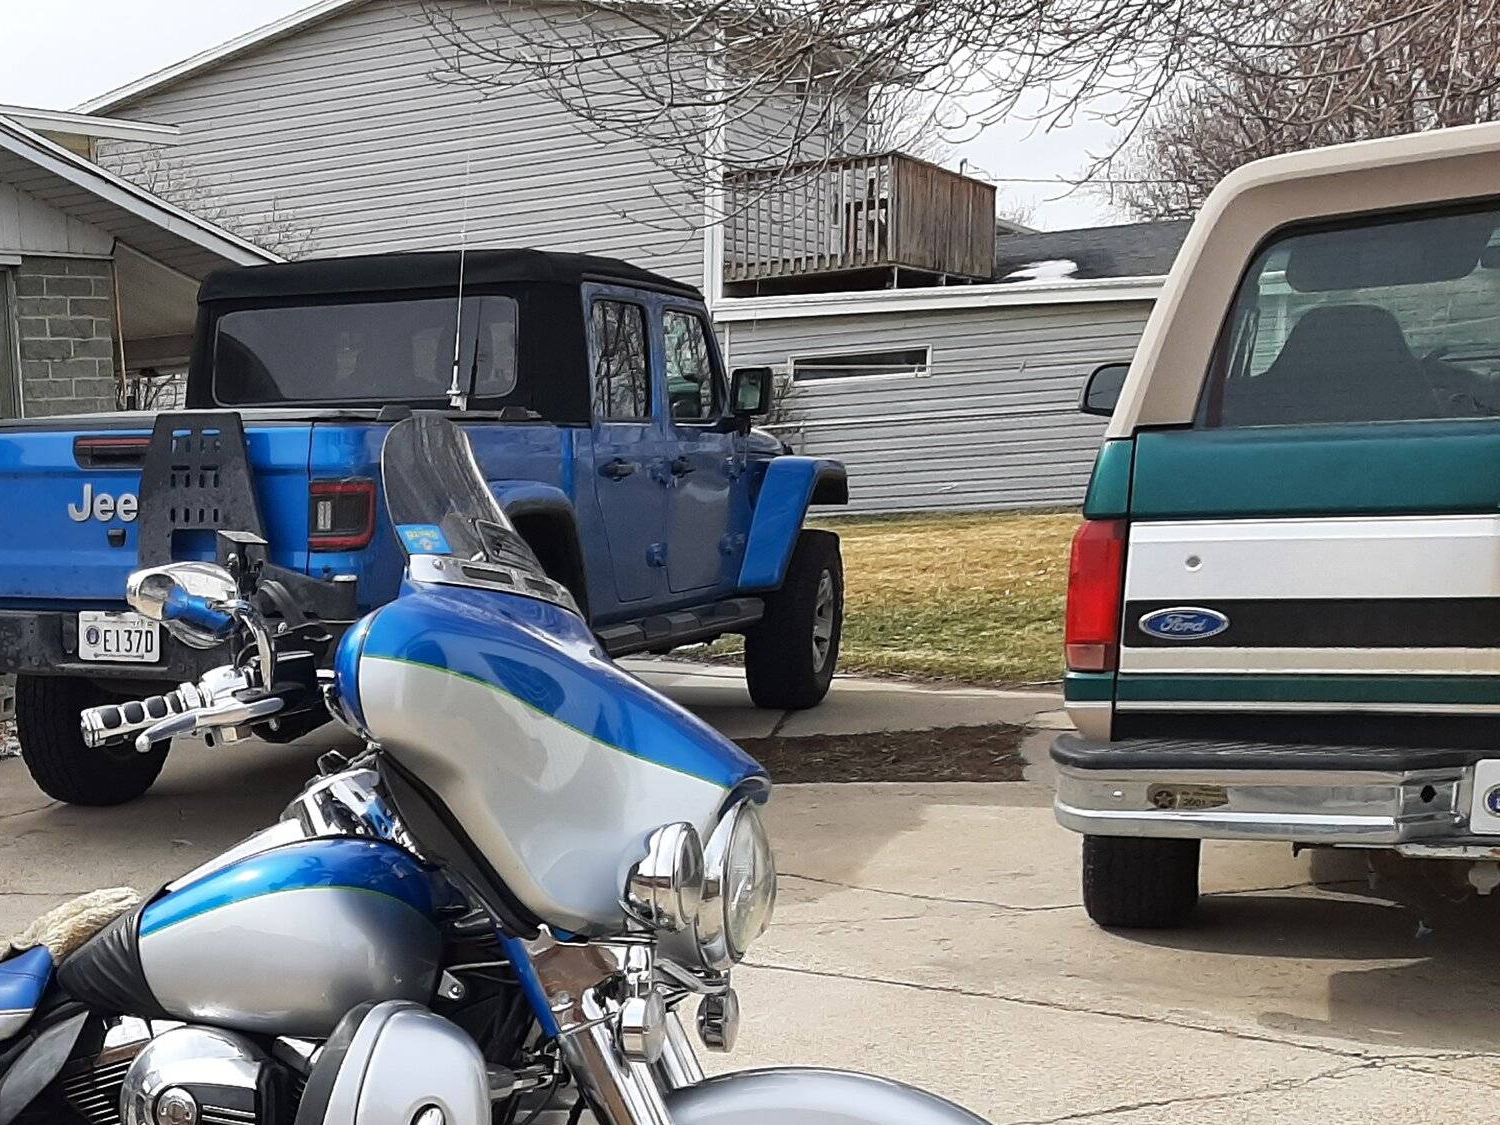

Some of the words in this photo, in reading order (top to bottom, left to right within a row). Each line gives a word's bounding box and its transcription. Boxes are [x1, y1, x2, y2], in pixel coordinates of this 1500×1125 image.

[68, 483, 139, 522] Jee
[1161, 613, 1206, 632] Ford
[103, 629, 154, 653] E137D
